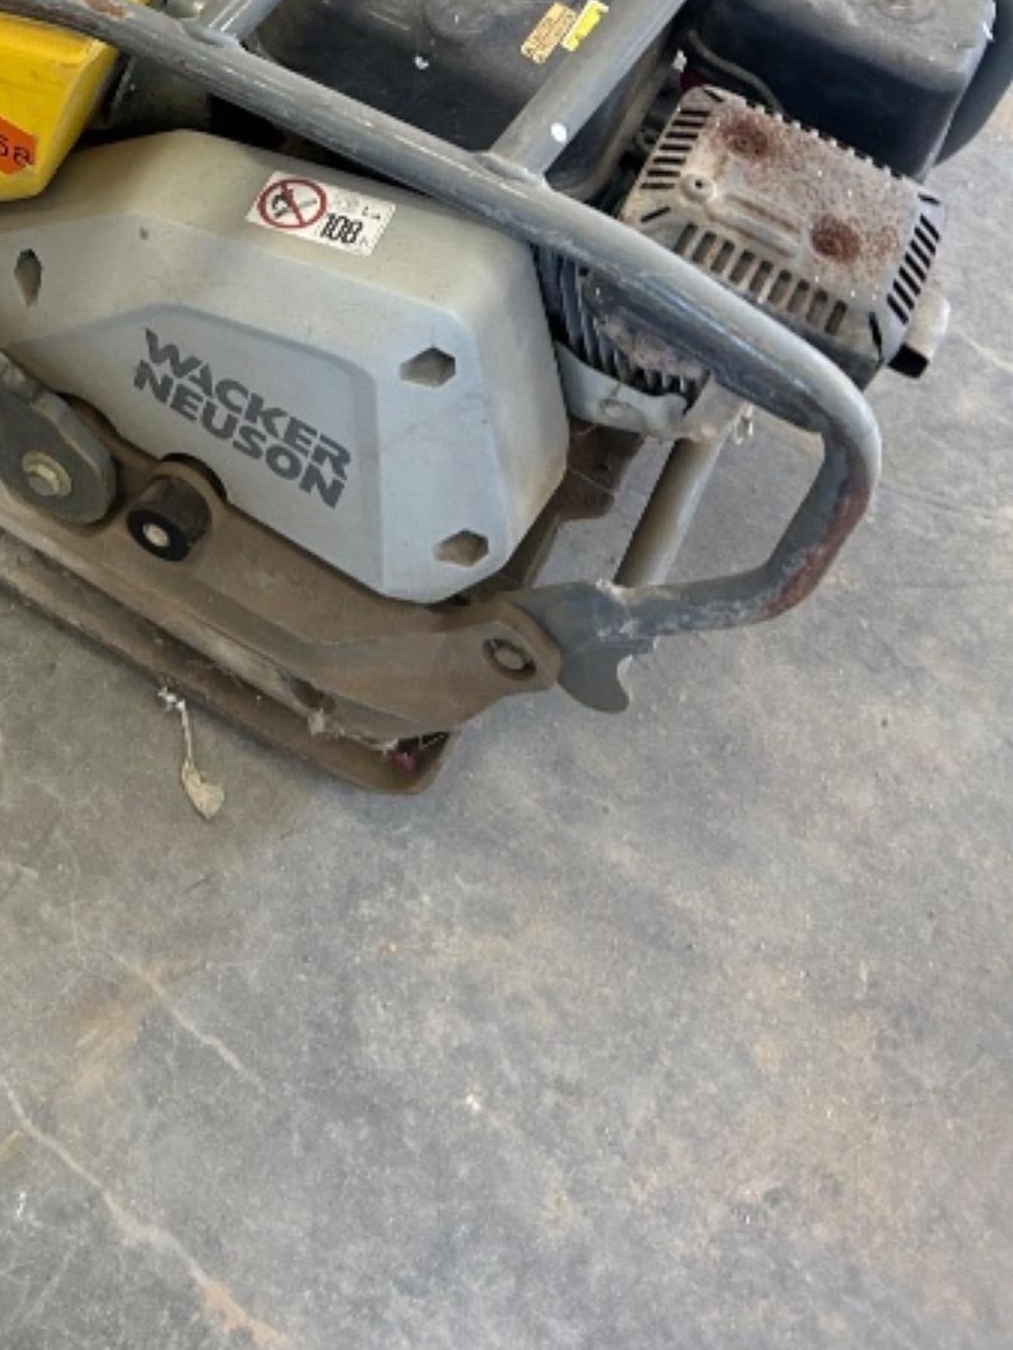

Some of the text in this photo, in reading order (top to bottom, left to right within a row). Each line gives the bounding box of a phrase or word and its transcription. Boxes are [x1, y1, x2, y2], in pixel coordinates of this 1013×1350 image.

[320, 213, 363, 244] 108
[133, 359, 345, 510] NEUSON
[144, 328, 352, 480] WACKER
